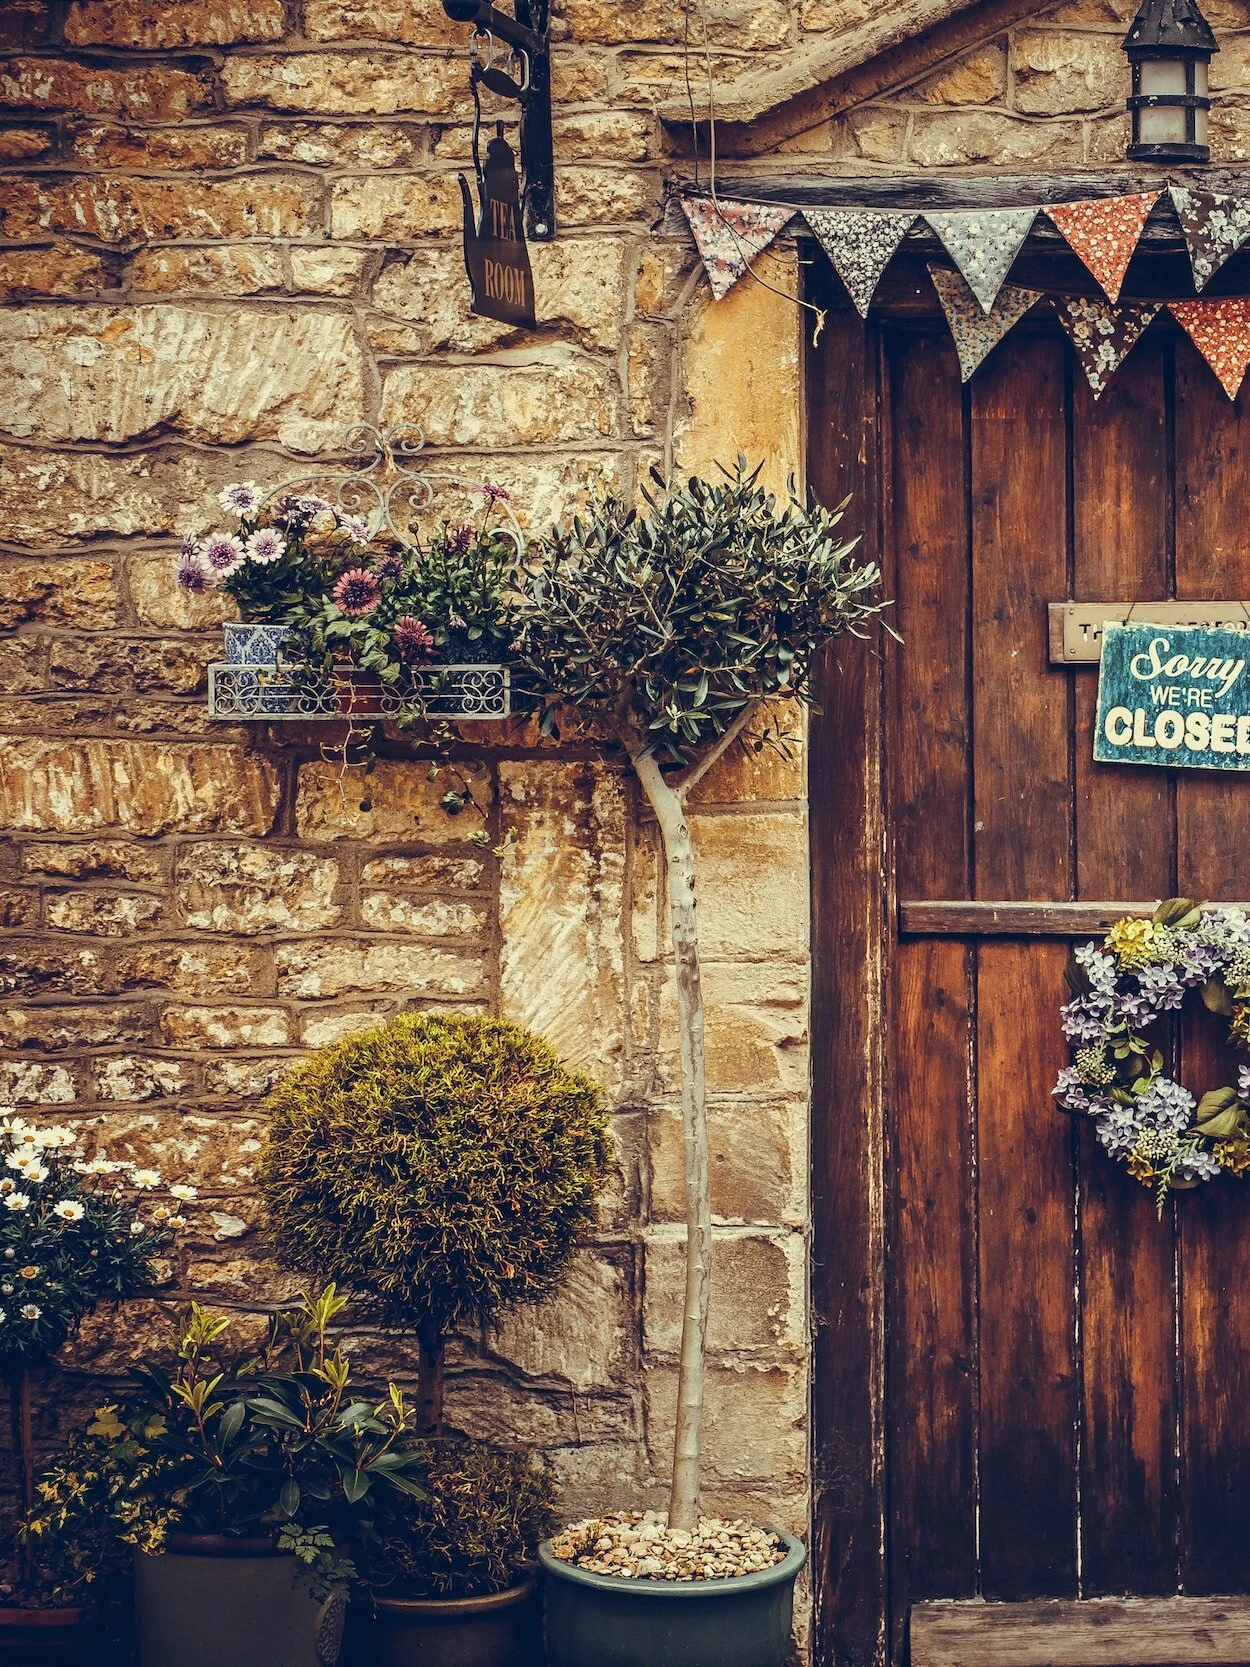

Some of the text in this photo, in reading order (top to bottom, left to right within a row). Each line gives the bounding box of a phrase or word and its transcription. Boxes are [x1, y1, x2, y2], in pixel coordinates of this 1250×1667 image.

[490, 198, 518, 244] TEA
[484, 258, 526, 307] ROOM
[1130, 637, 1246, 698] Sorry
[1150, 686, 1213, 708] WE'RE
